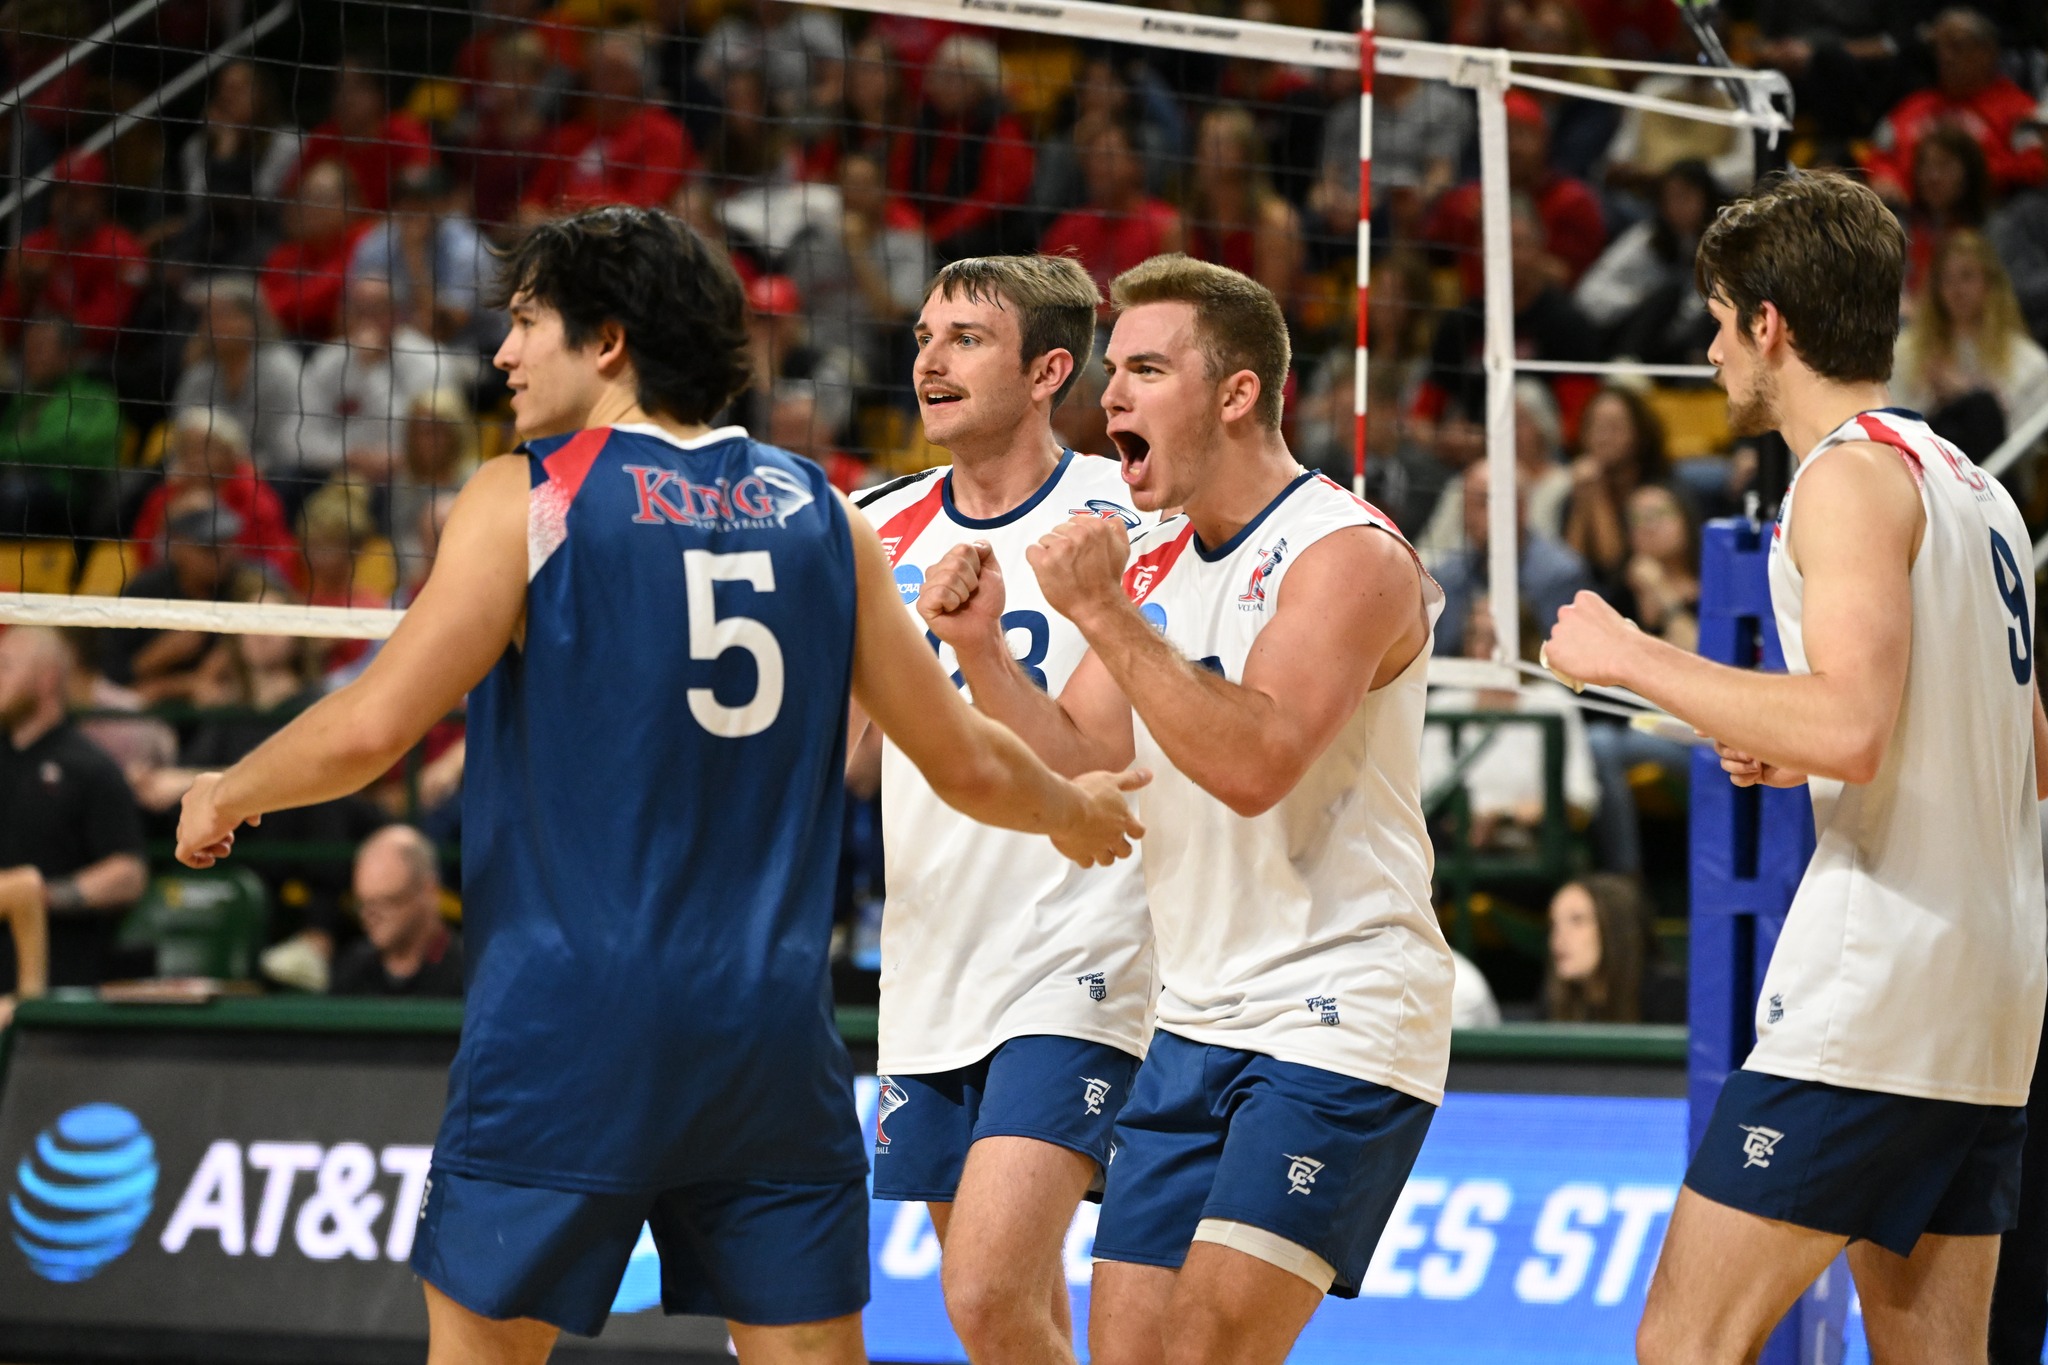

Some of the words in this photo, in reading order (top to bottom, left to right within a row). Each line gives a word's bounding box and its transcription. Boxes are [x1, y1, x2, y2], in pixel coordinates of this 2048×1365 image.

[684, 549, 785, 739] 5
[1988, 526, 2032, 686] 9
[1091, 990, 1105, 999] USA
[160, 1138, 435, 1262] AT&T
[1515, 1182, 1681, 1304] ST
